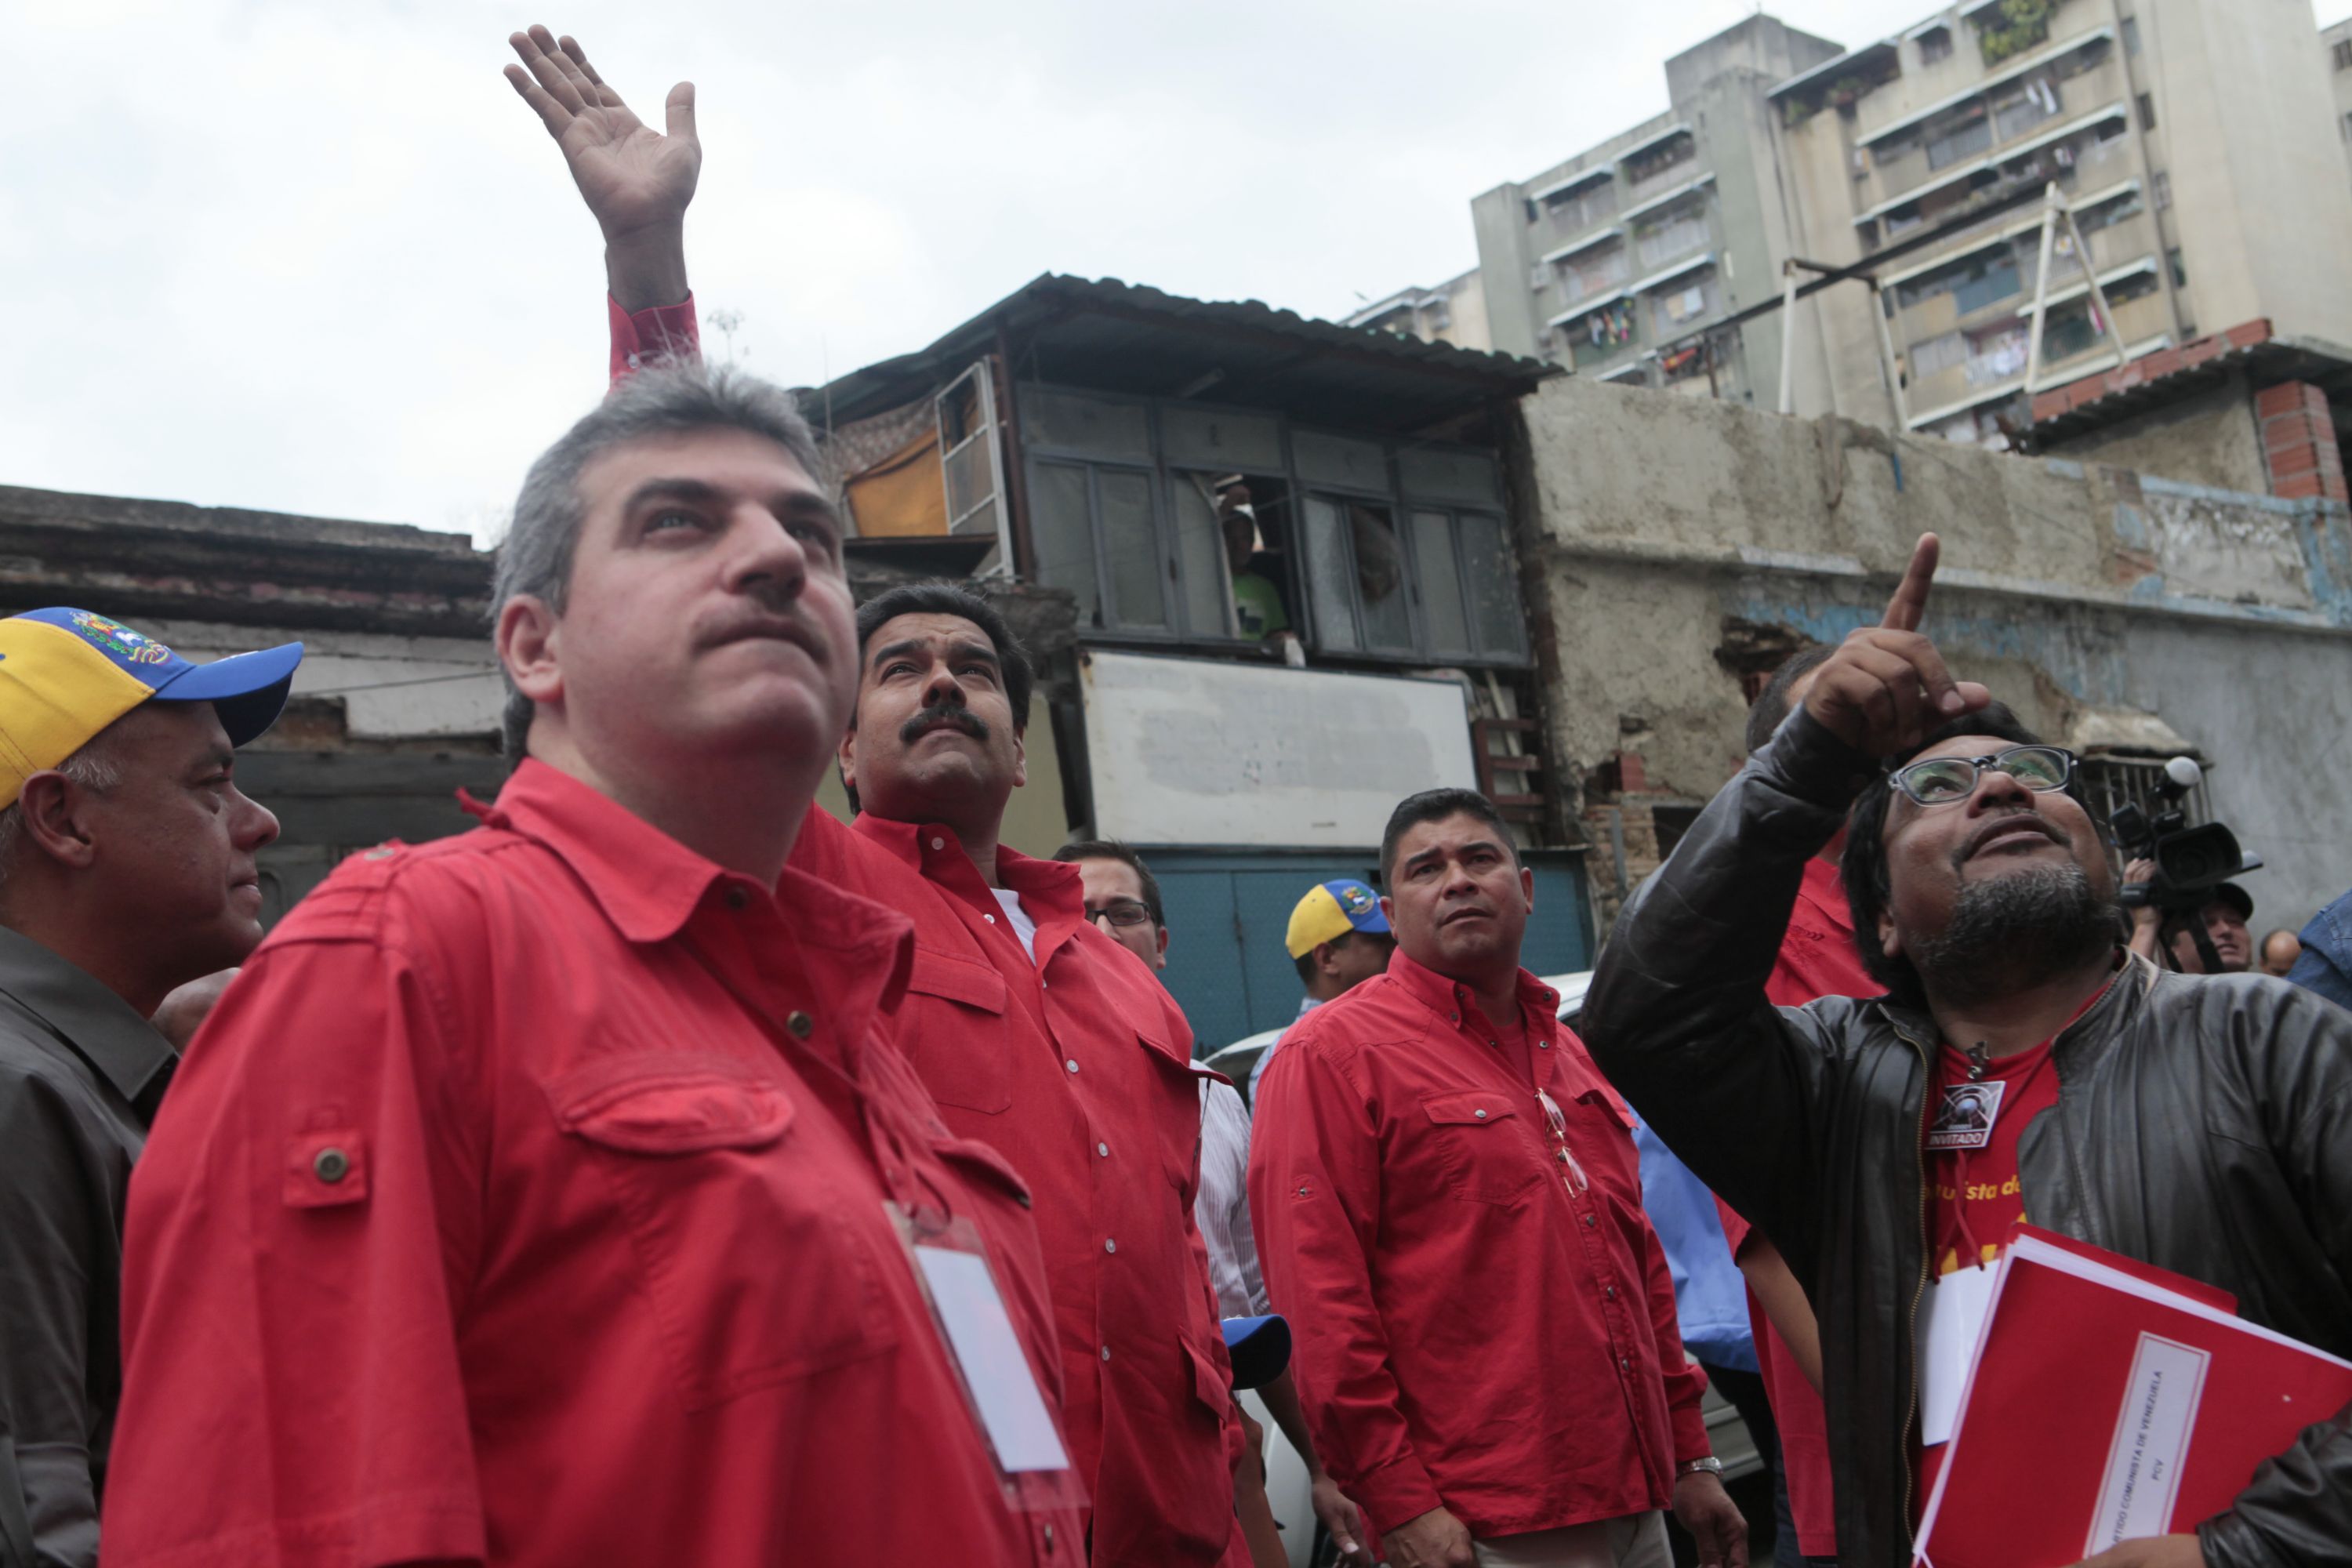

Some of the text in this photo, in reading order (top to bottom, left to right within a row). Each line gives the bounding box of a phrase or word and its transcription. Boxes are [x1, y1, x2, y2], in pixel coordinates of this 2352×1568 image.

[1929, 1133, 1983, 1145] INVITADO
[2112, 1370, 2163, 1544] RTIDO COMUNISTA DE VENEZUELA
[2151, 1458, 2165, 1481] PCV
